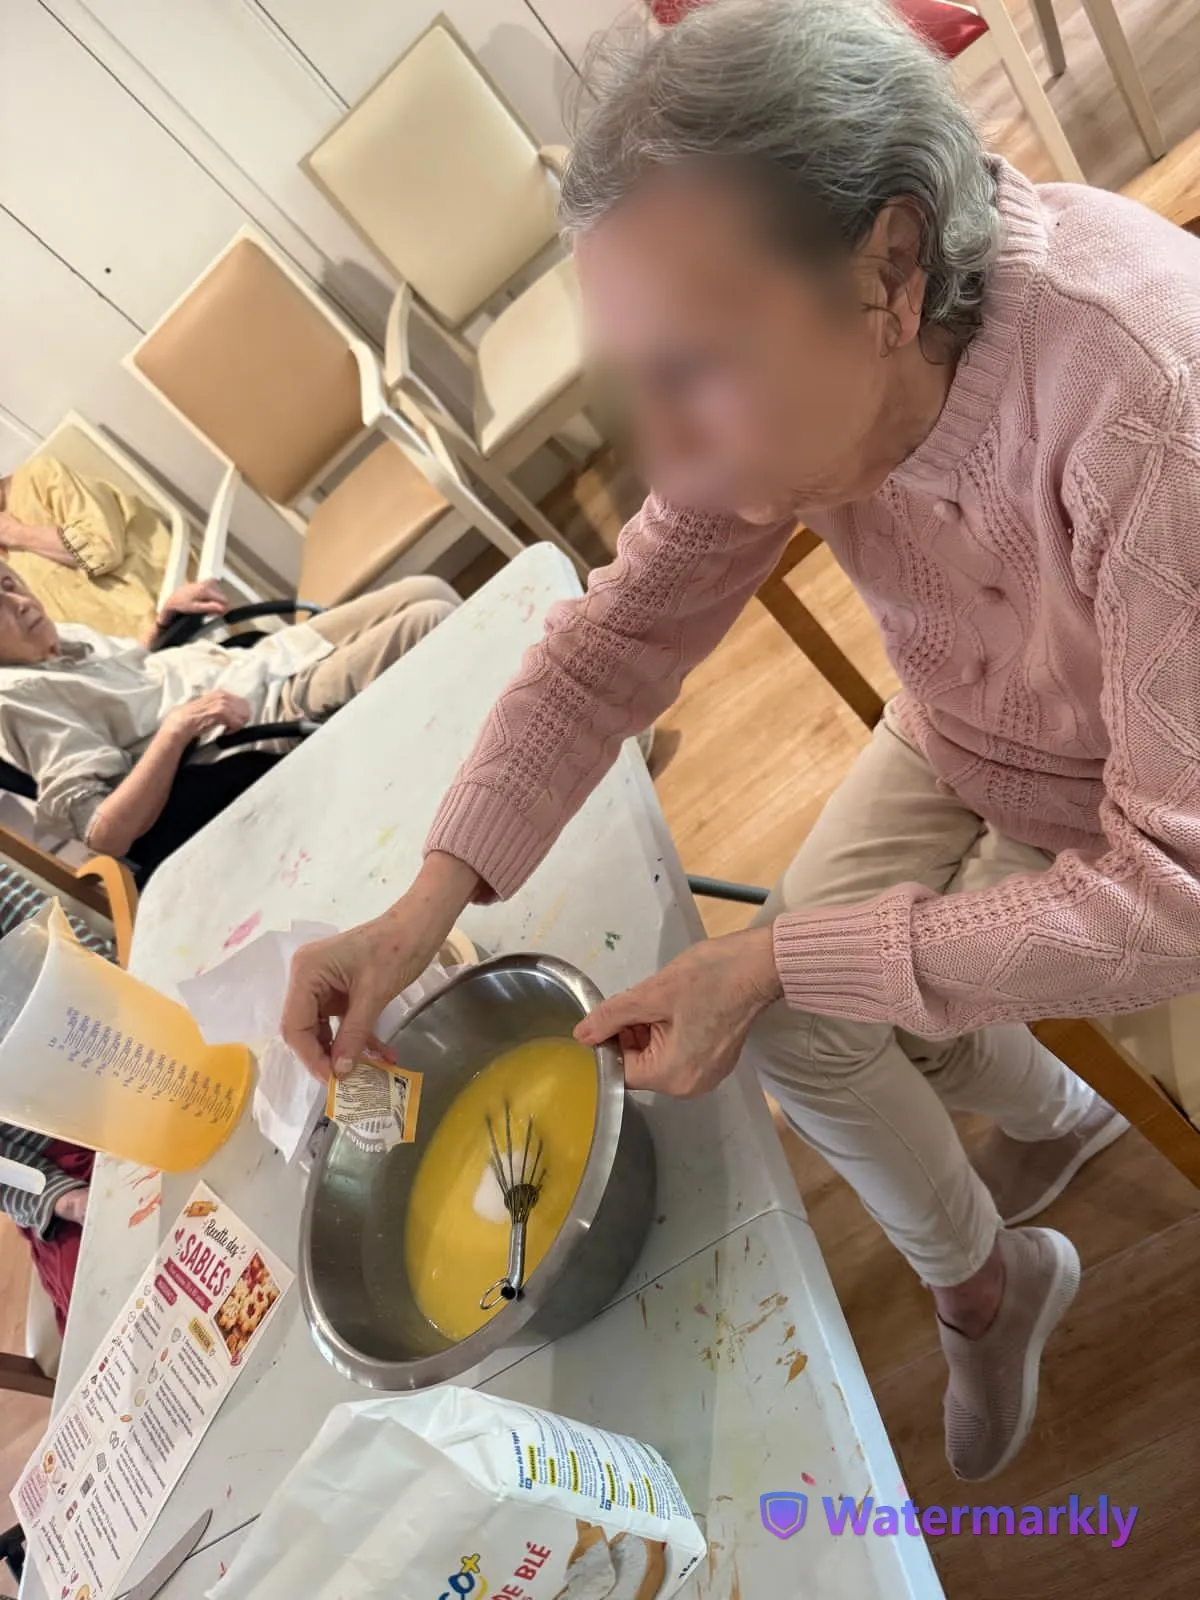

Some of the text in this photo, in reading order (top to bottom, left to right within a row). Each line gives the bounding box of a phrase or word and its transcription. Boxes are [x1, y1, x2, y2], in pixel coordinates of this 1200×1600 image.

[205, 1218, 240, 1259] Recette des
[179, 1233, 232, 1297] SABLÉS
[513, 1541, 552, 1581] BLÉ
